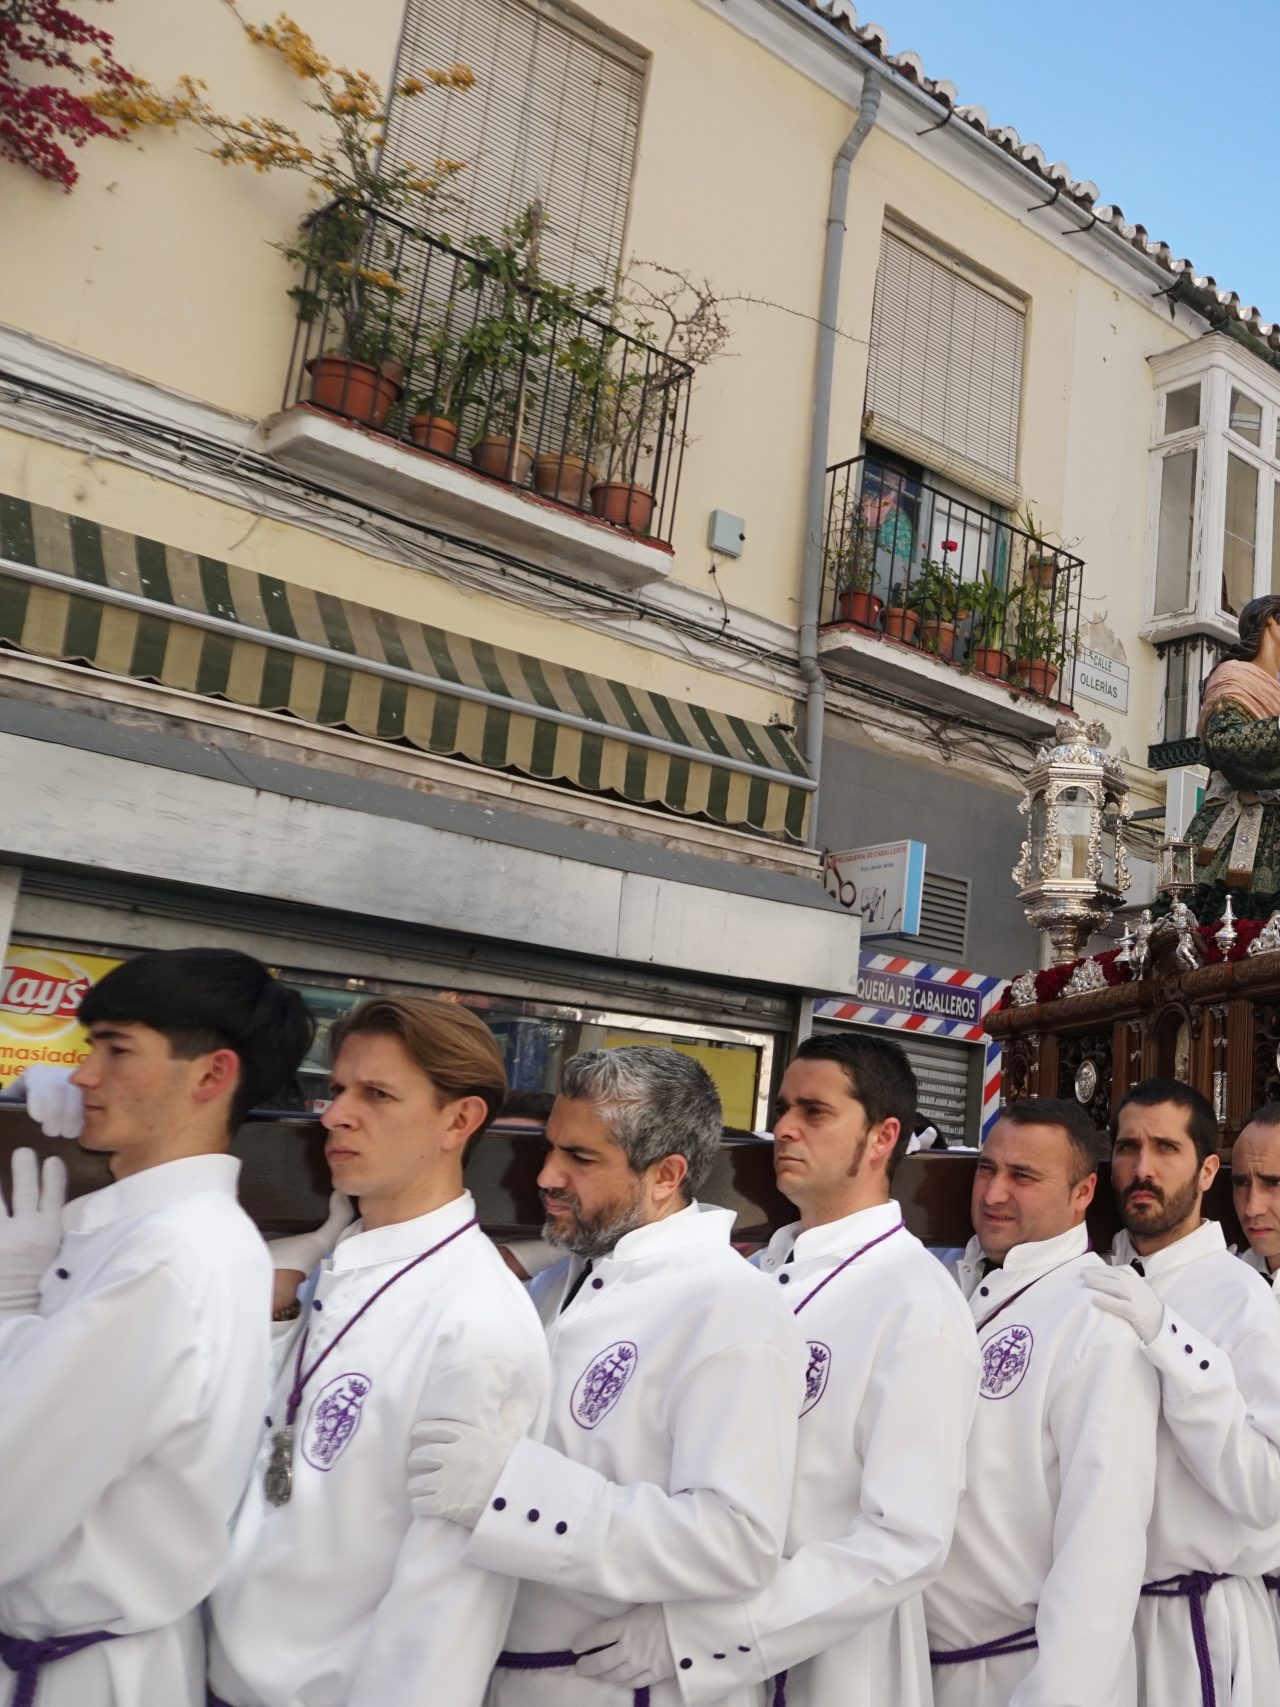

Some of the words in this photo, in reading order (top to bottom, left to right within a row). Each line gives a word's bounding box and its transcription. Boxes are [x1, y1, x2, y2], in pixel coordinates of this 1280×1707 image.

[1093, 655, 1112, 672] CALLE
[1080, 673, 1117, 698] OLLERÍAS
[898, 986, 911, 1007] DE
[913, 988, 976, 1019] CABALLEROS
